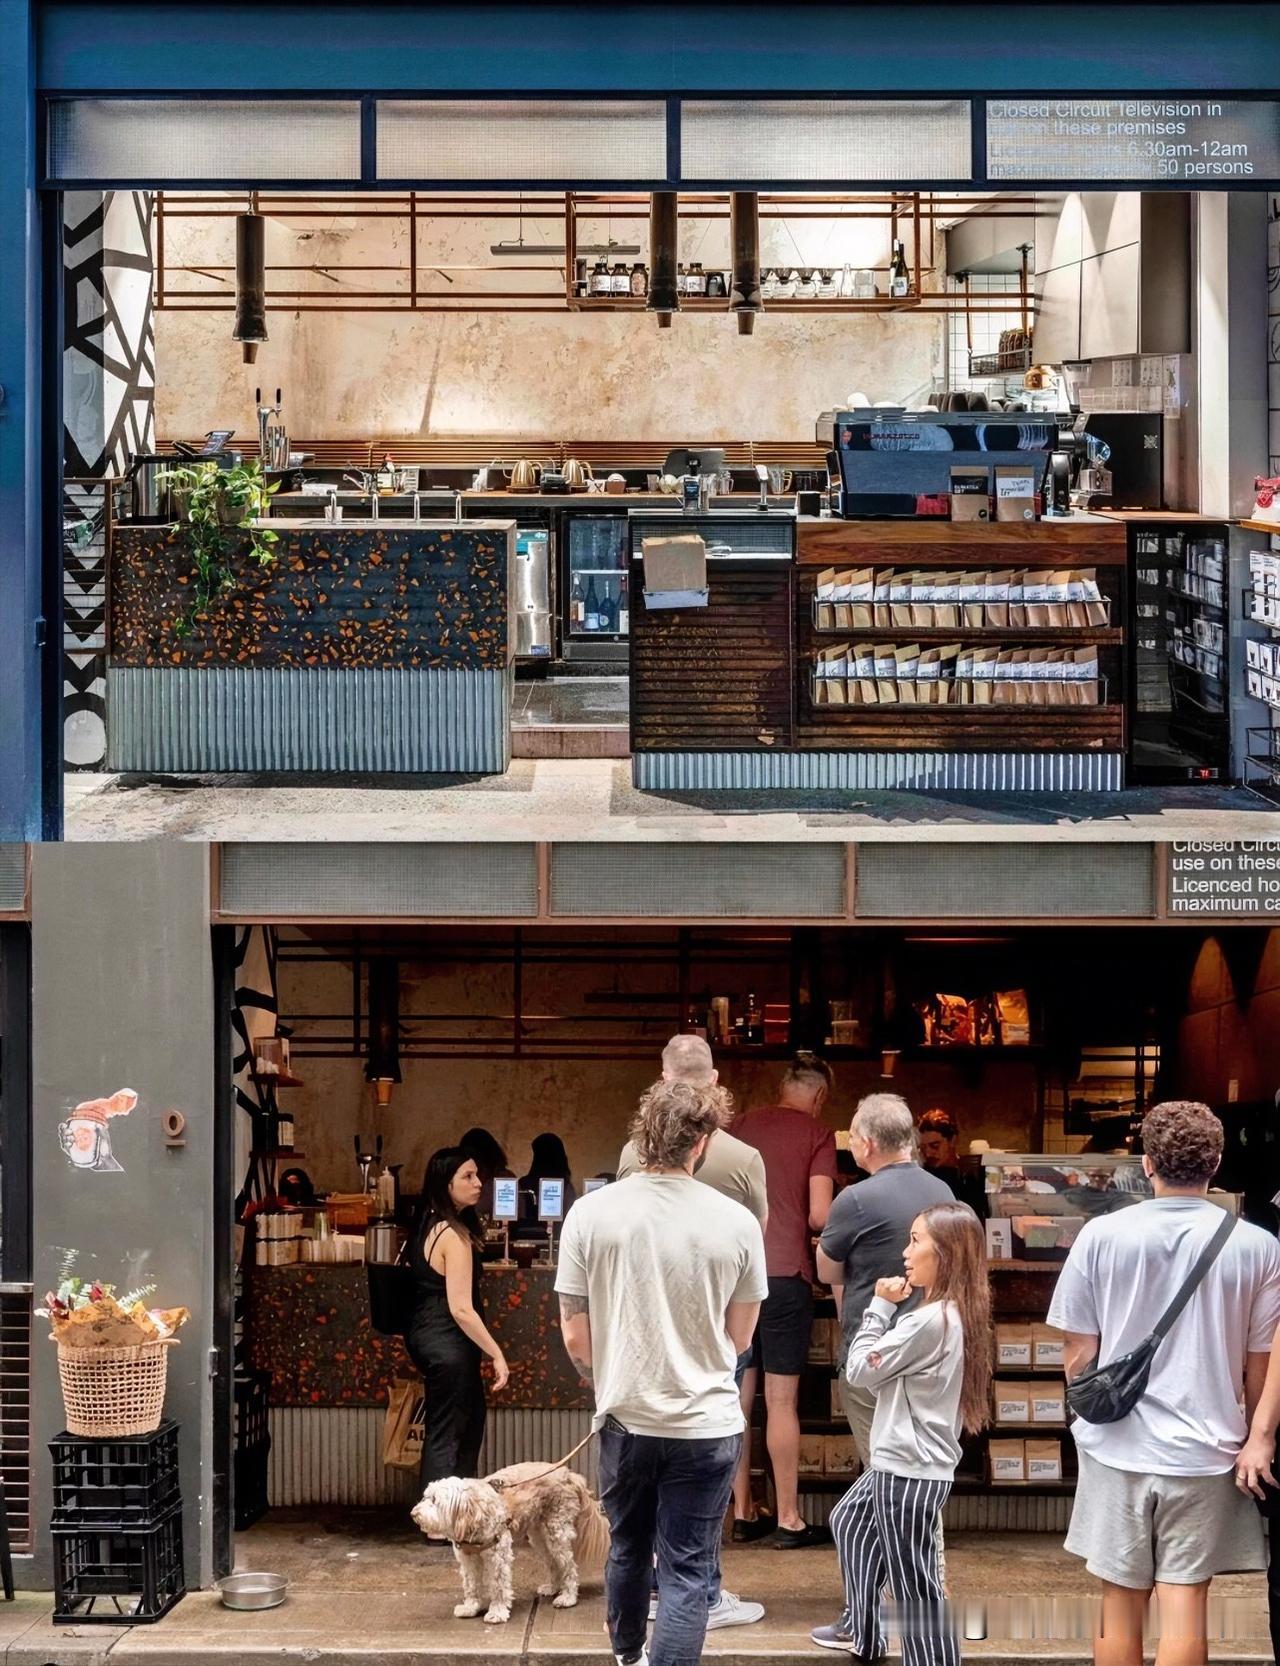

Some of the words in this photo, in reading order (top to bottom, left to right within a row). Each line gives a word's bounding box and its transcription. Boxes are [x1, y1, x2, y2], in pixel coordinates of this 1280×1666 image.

[989, 102, 1049, 117] Closed
[1056, 101, 1110, 117] Circuit
[1118, 101, 1201, 117] Television
[1207, 101, 1222, 117] in
[1054, 121, 1101, 135] these
[1107, 121, 1186, 139] premises
[1127, 141, 1247, 157] 6.30am-12am
[1158, 161, 1178, 175] 50
[1185, 162, 1253, 177] persons
[1173, 840, 1235, 852] Closed
[1172, 858, 1204, 870] use
[1210, 858, 1232, 870] on
[1172, 877, 1252, 893] Licenced
[1172, 895, 1259, 911] maximum
